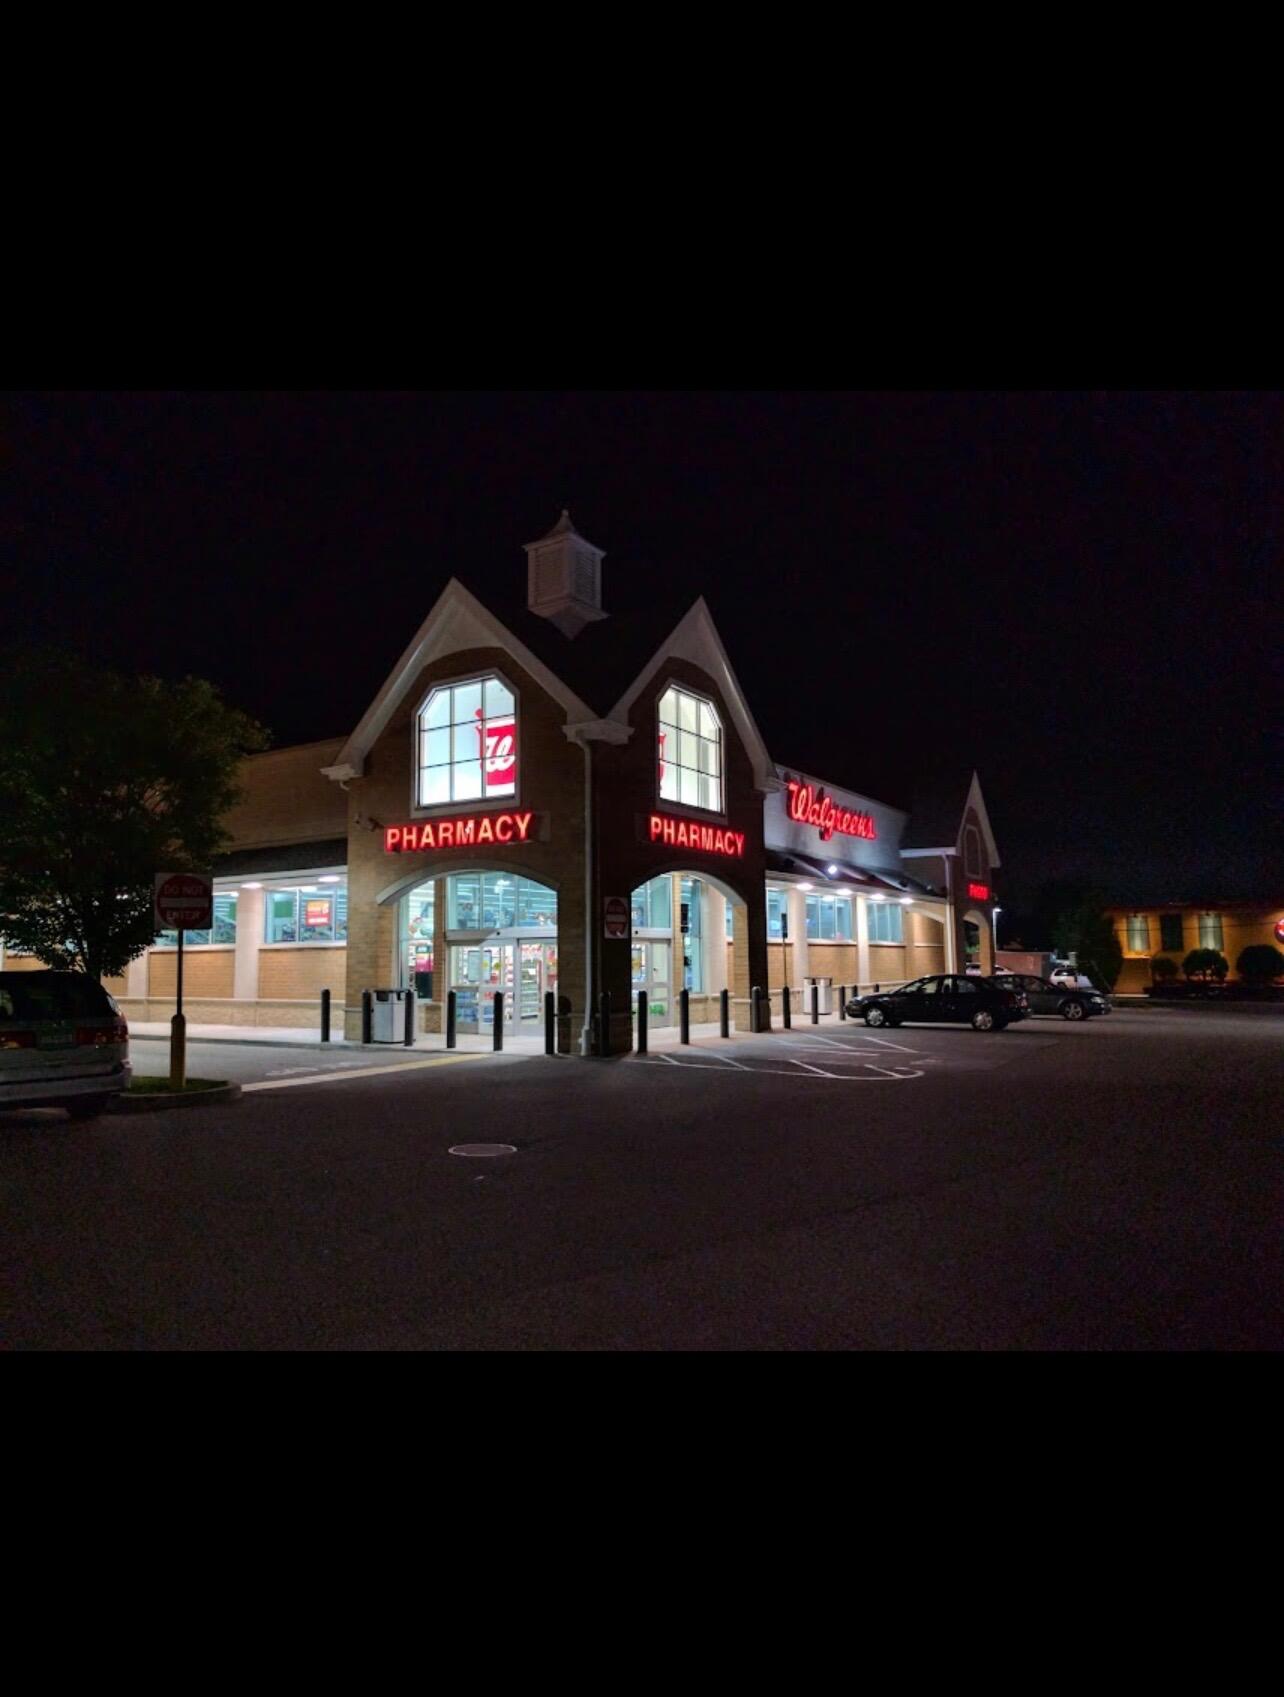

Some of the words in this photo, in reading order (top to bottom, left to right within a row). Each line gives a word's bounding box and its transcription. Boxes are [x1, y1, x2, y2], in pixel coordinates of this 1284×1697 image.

[385, 812, 532, 853] PHARMACY
[788, 782, 877, 840] Walgreens
[649, 815, 746, 858] PHARMACY
